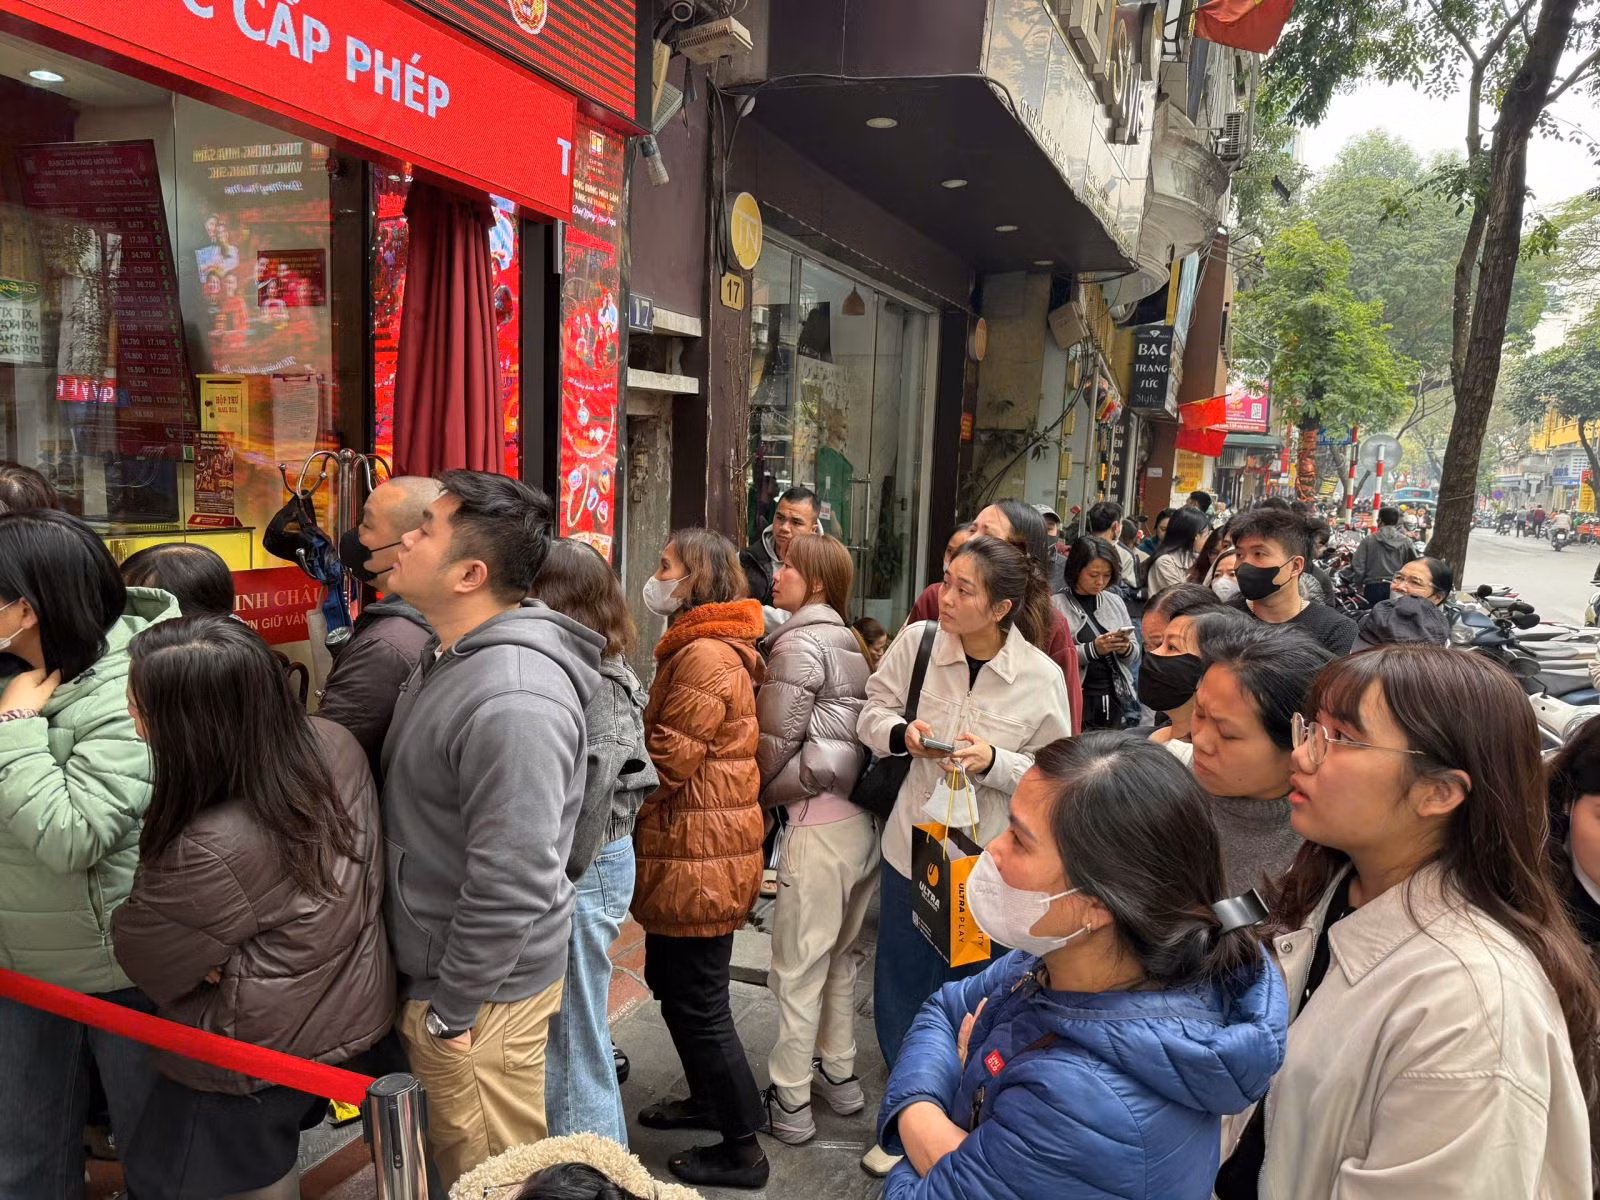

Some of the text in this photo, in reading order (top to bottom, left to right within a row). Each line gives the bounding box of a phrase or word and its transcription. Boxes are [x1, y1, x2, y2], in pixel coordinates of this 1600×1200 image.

[346, 35, 450, 118] PHÉP
[727, 279, 741, 304] 17
[635, 298, 651, 327] 17
[1138, 343, 1168, 359] BẠC
[1135, 363, 1168, 373] TRANG
[1140, 377, 1158, 388] SỨC
[233, 591, 268, 612] INH
[286, 611, 308, 626] VÀN
[919, 880, 940, 910] ULTRA
